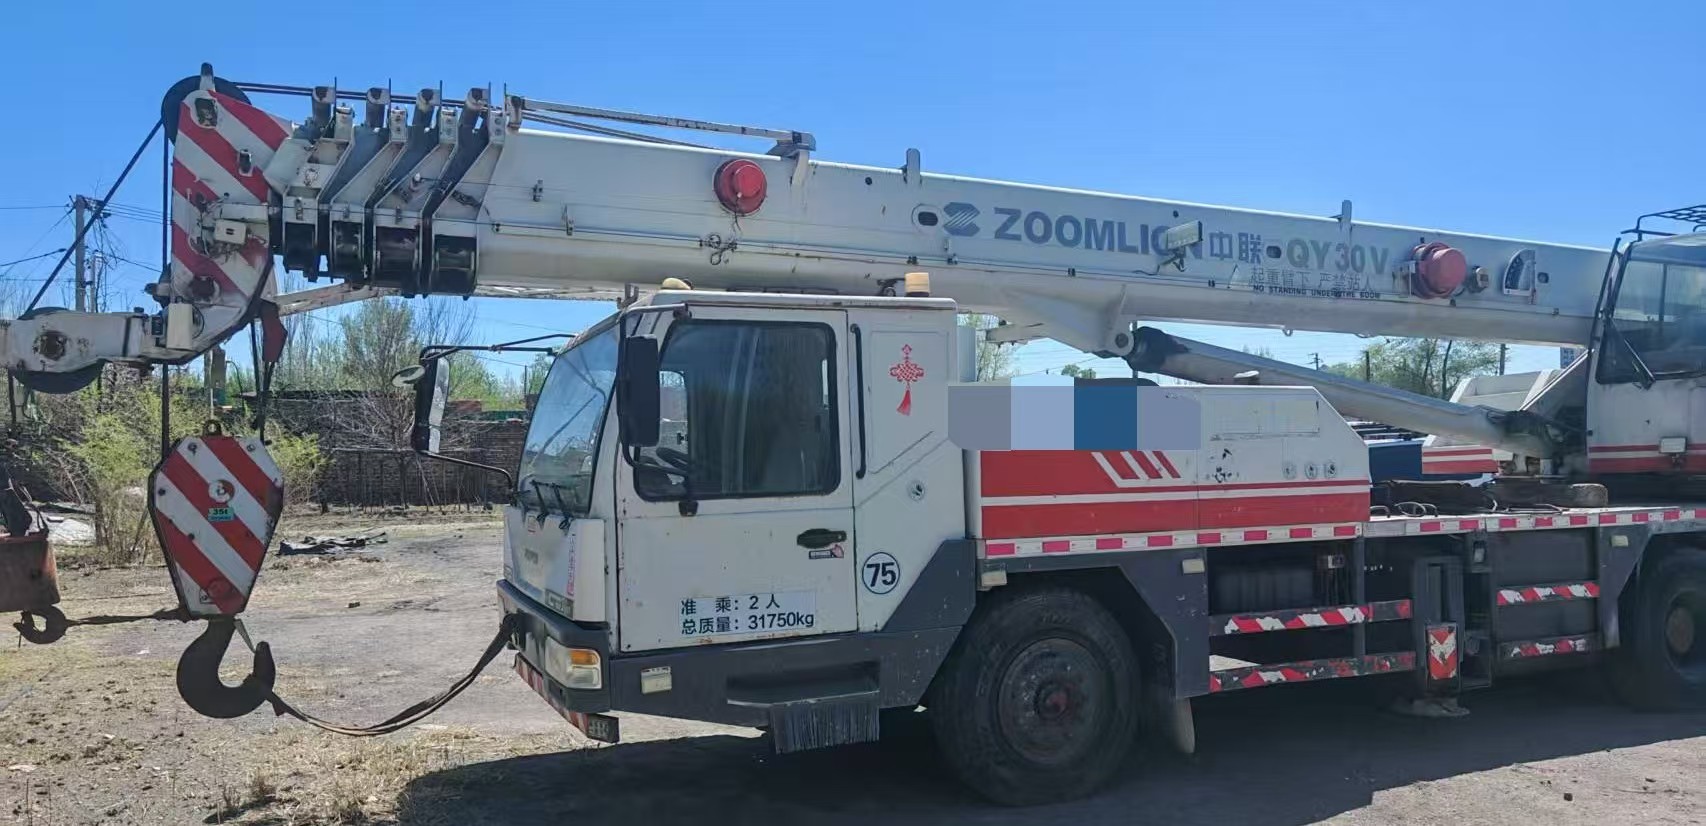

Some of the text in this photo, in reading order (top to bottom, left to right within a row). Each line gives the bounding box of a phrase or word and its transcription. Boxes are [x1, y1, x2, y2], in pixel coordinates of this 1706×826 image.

[994, 207, 1203, 259] ZOOMLIO
[1209, 231, 1262, 264] 中联
[1253, 284, 1265, 292] NO
[1269, 286, 1307, 294] STANDING
[866, 562, 896, 587] 75
